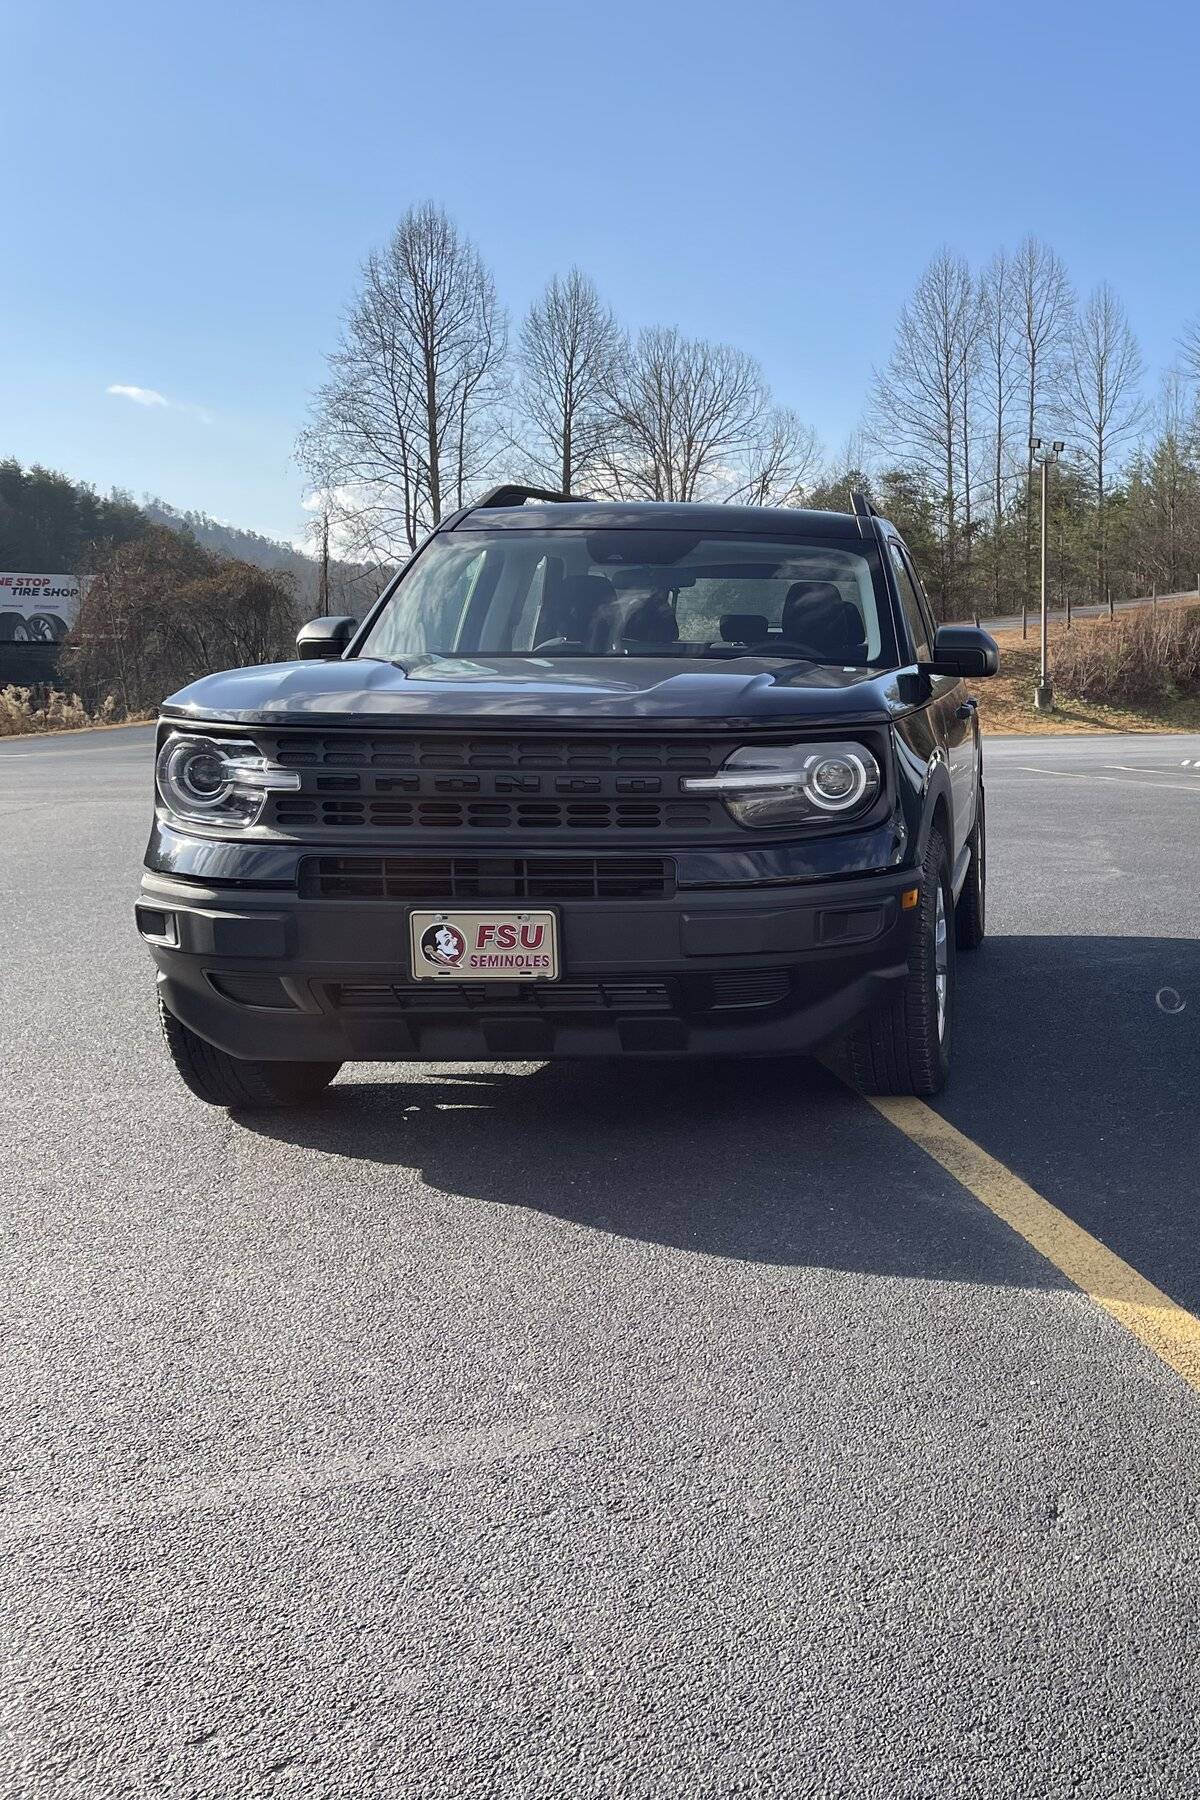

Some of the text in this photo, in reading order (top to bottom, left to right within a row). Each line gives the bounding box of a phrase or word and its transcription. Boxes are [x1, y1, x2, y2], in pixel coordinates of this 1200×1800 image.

[16, 578, 51, 587] STOP
[11, 587, 79, 597] TIRE SHOP
[317, 774, 662, 793] BRONCO
[476, 923, 545, 950] FSU
[470, 955, 550, 968] SEMINOLES
